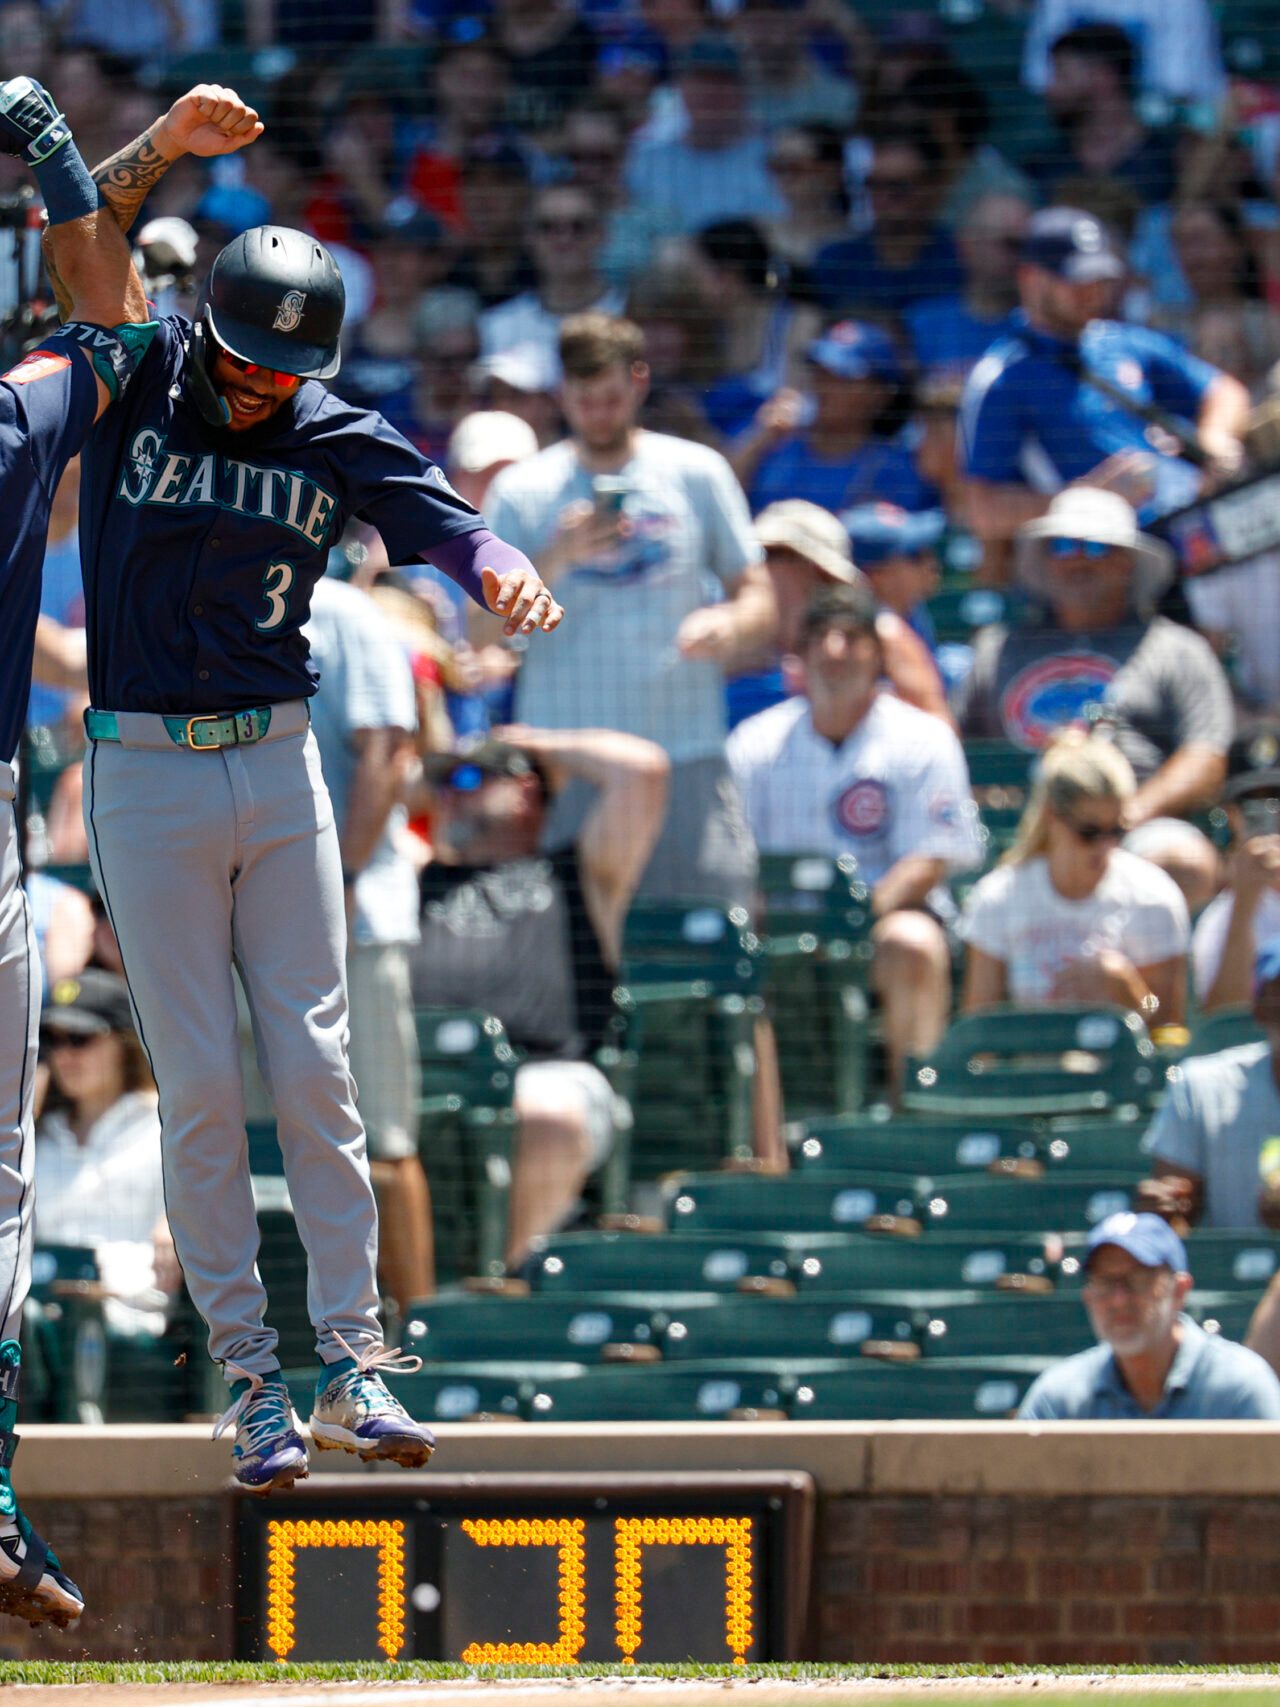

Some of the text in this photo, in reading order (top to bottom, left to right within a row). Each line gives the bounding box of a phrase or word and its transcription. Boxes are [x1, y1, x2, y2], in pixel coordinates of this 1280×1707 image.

[117, 427, 338, 550] SEATTLE
[255, 560, 296, 632] 3
[242, 711, 254, 739] 3
